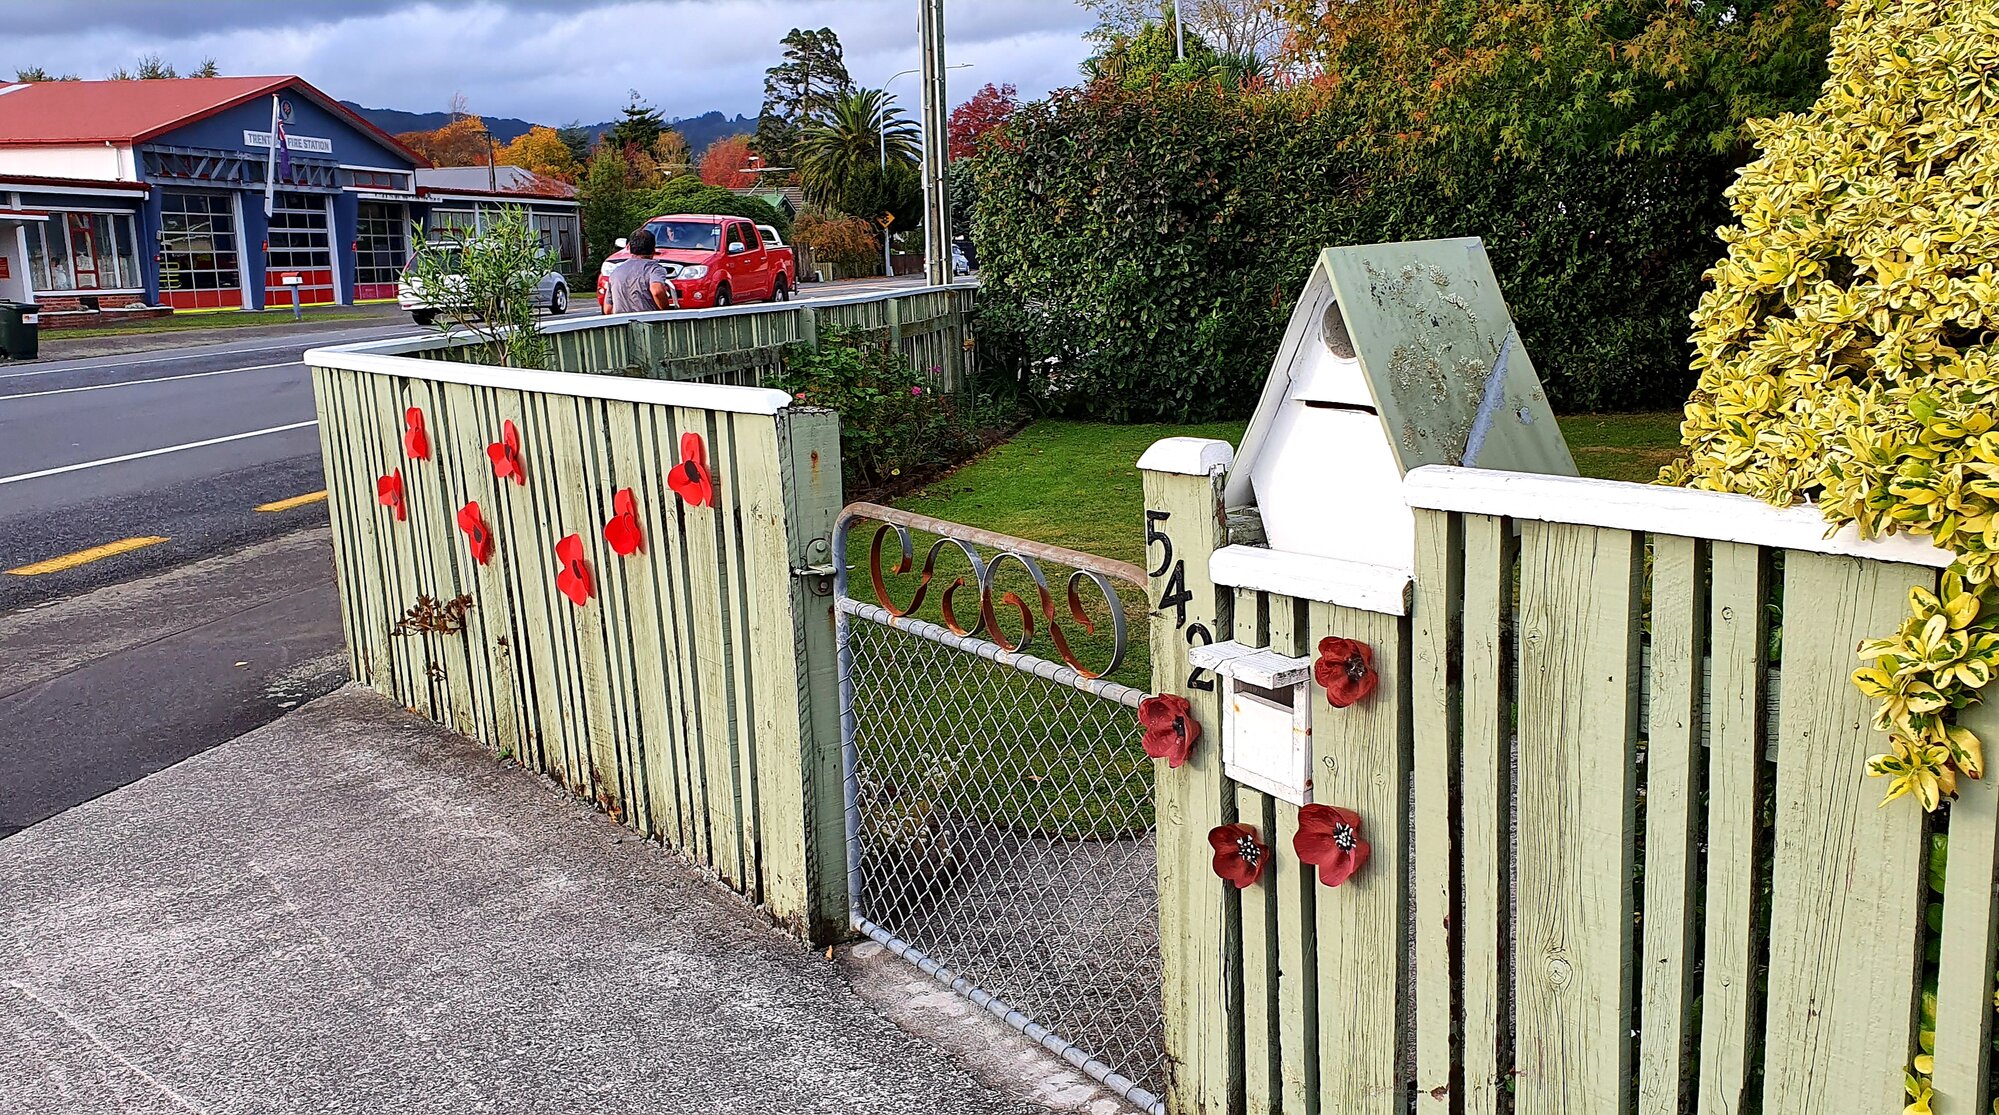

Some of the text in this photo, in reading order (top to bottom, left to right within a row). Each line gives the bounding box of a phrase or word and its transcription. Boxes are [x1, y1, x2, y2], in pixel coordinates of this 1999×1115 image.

[247, 132, 330, 151] TRENT FIRE STATION
[1146, 509, 1214, 692] 542
